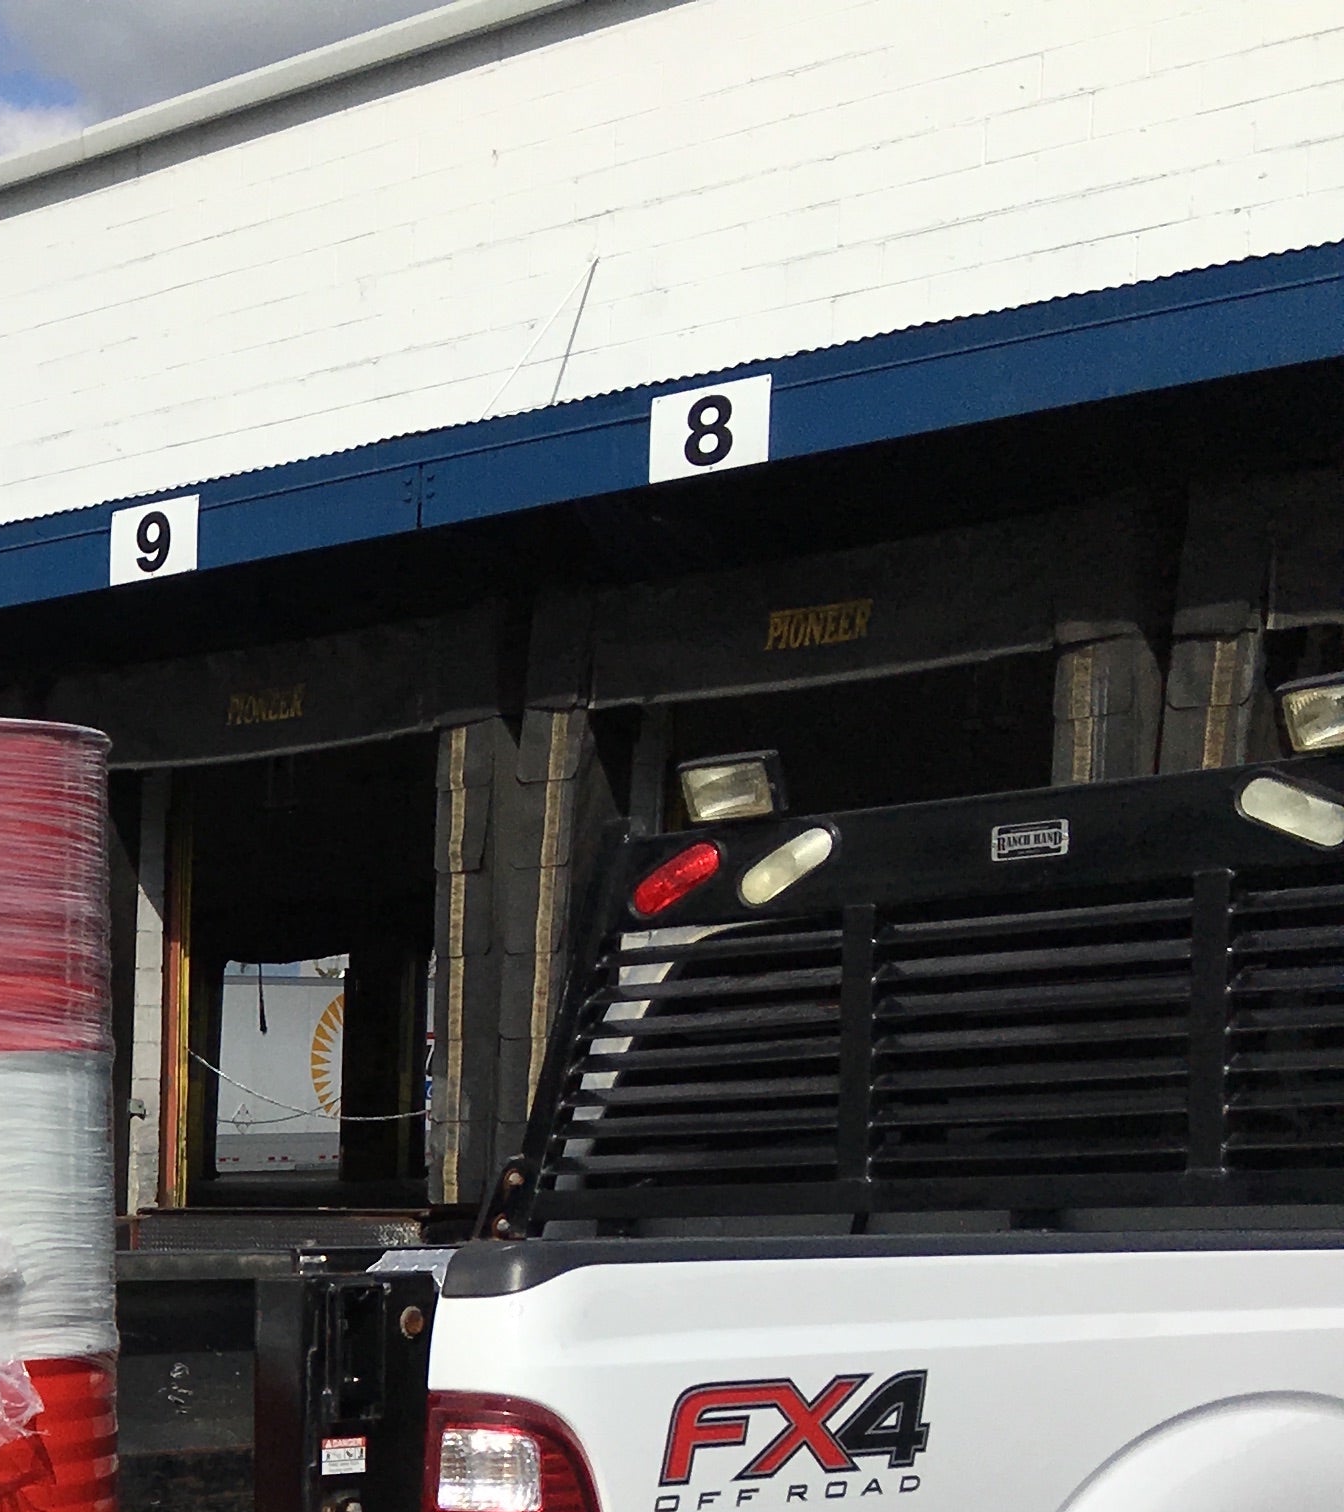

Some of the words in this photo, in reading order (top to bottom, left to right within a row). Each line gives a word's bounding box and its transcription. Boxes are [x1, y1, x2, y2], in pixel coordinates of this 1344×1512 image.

[683, 395, 734, 468] 8
[135, 510, 172, 572] 9
[764, 599, 873, 650] PIONEER
[997, 835, 1031, 852] RANCH
[1034, 831, 1062, 846] HAND
[658, 1368, 931, 1487] FX4
[786, 1475, 921, 1502] ROAD
